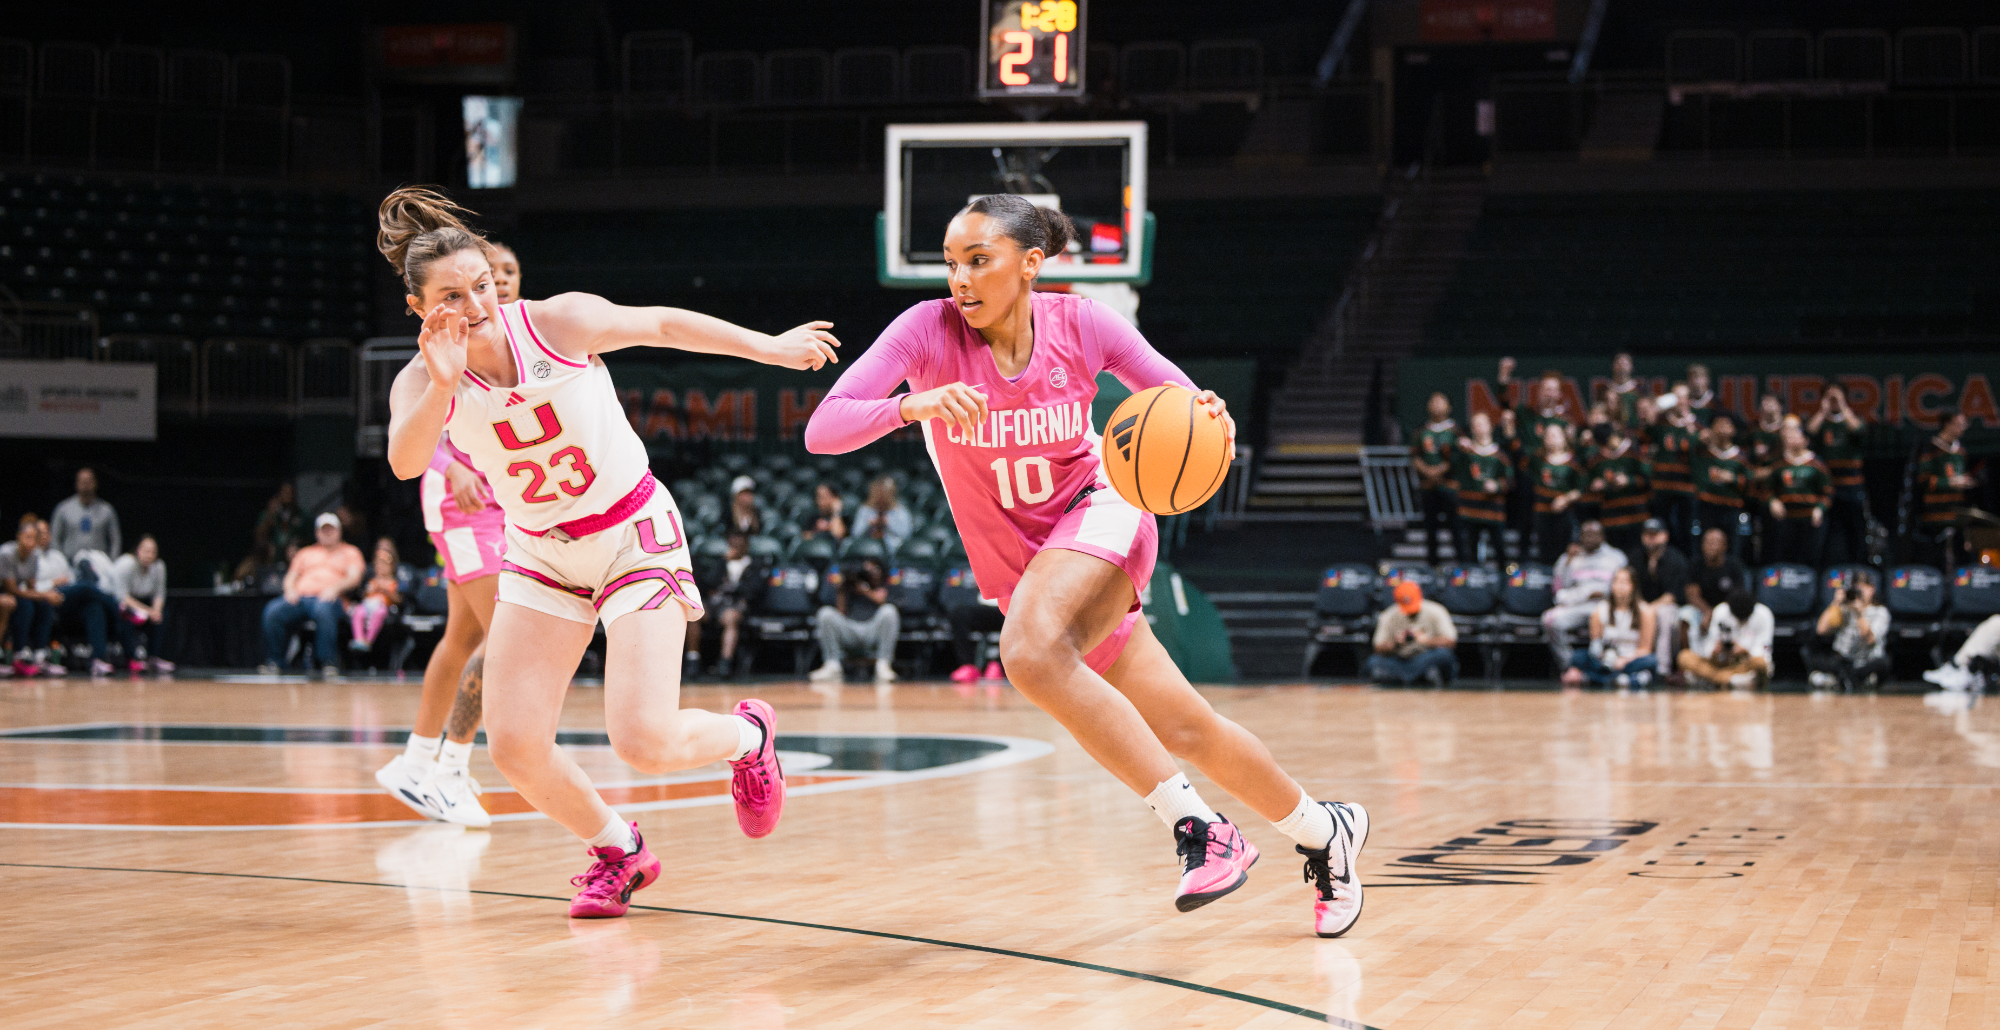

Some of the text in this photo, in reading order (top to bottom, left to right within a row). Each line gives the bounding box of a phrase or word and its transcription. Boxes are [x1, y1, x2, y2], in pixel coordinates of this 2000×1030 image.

[1021, 0, 1077, 32] 1:28
[1000, 31, 1067, 85] 21
[491, 400, 563, 451] U
[616, 387, 757, 441] IAMI
[507, 444, 597, 503] 23
[990, 456, 1054, 509] 10
[633, 510, 682, 554] U
